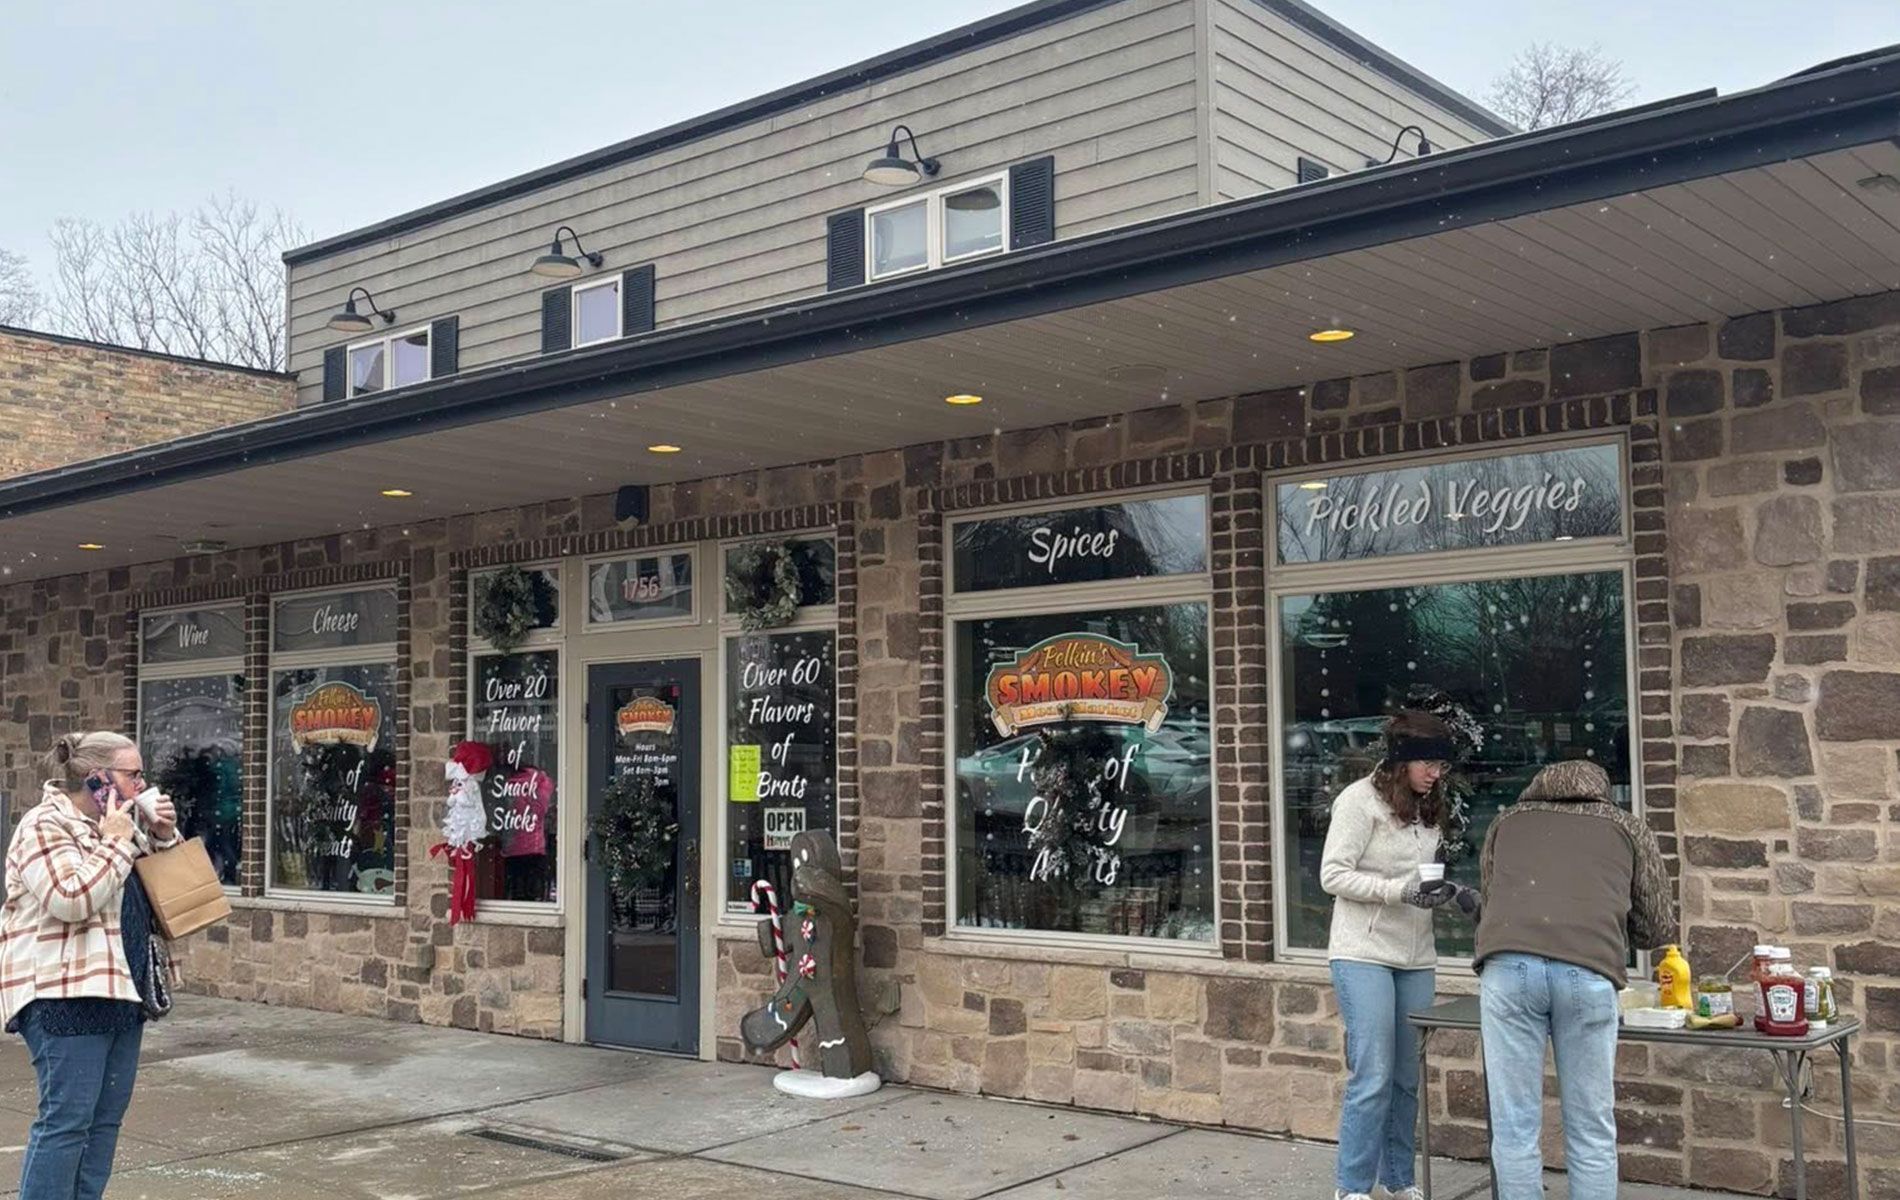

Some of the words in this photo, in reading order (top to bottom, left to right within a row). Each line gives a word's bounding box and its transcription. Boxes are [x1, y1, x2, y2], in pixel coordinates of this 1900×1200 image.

[1306, 480, 1430, 536] Pickled
[1449, 472, 1587, 533] Veggies
[1028, 526, 1119, 574] Spices
[622, 575, 660, 600] 1756
[312, 605, 360, 634] Cheese
[178, 624, 209, 648] Wine
[486, 677, 521, 702] Over
[524, 674, 548, 699] 20
[743, 662, 787, 689] Over
[792, 658, 821, 685] 60
[997, 666, 1159, 706] SMOKEY
[294, 706, 375, 733] SMOKEY
[490, 707, 543, 733] Flavors
[749, 695, 815, 725] Flavors
[507, 740, 527, 771] of
[770, 732, 795, 768] of
[346, 760, 365, 794] of
[1104, 743, 1141, 791] of
[491, 771, 539, 799] Snack
[756, 771, 808, 800] Brats
[492, 805, 539, 833] Sticks
[766, 811, 803, 832] OPEN
